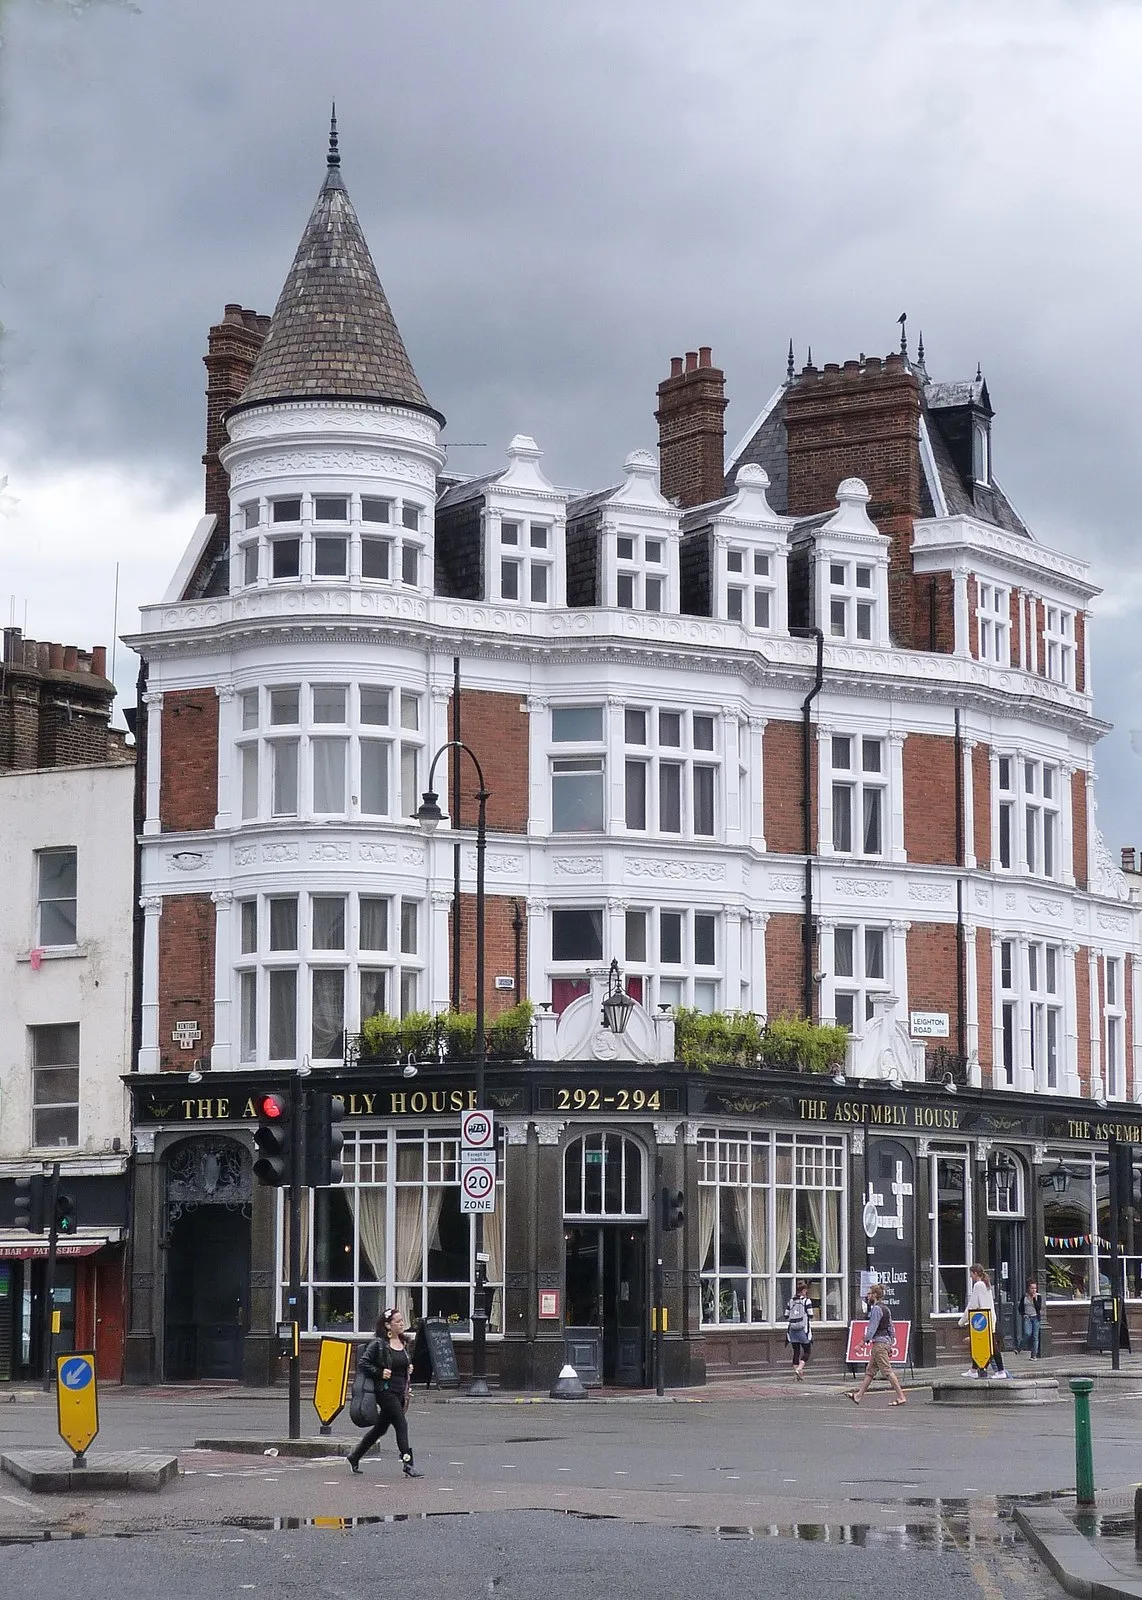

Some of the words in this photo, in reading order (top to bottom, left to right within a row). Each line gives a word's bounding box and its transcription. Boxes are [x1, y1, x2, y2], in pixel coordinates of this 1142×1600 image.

[913, 1018, 945, 1026] LEIGHTON
[913, 1026, 932, 1034] ROAD
[557, 1089, 660, 1110] 292-294
[182, 1098, 229, 1119] THE
[799, 1099, 828, 1120] THE
[834, 1102, 907, 1125] ASSEMBLY
[914, 1107, 960, 1129] HOUSE
[1068, 1120, 1090, 1139] THE
[1095, 1123, 1142, 1143] ASSEMB
[468, 1176, 488, 1189] 20
[464, 1200, 491, 1209] ZONE
[33, 1246, 81, 1255] PATSERIE
